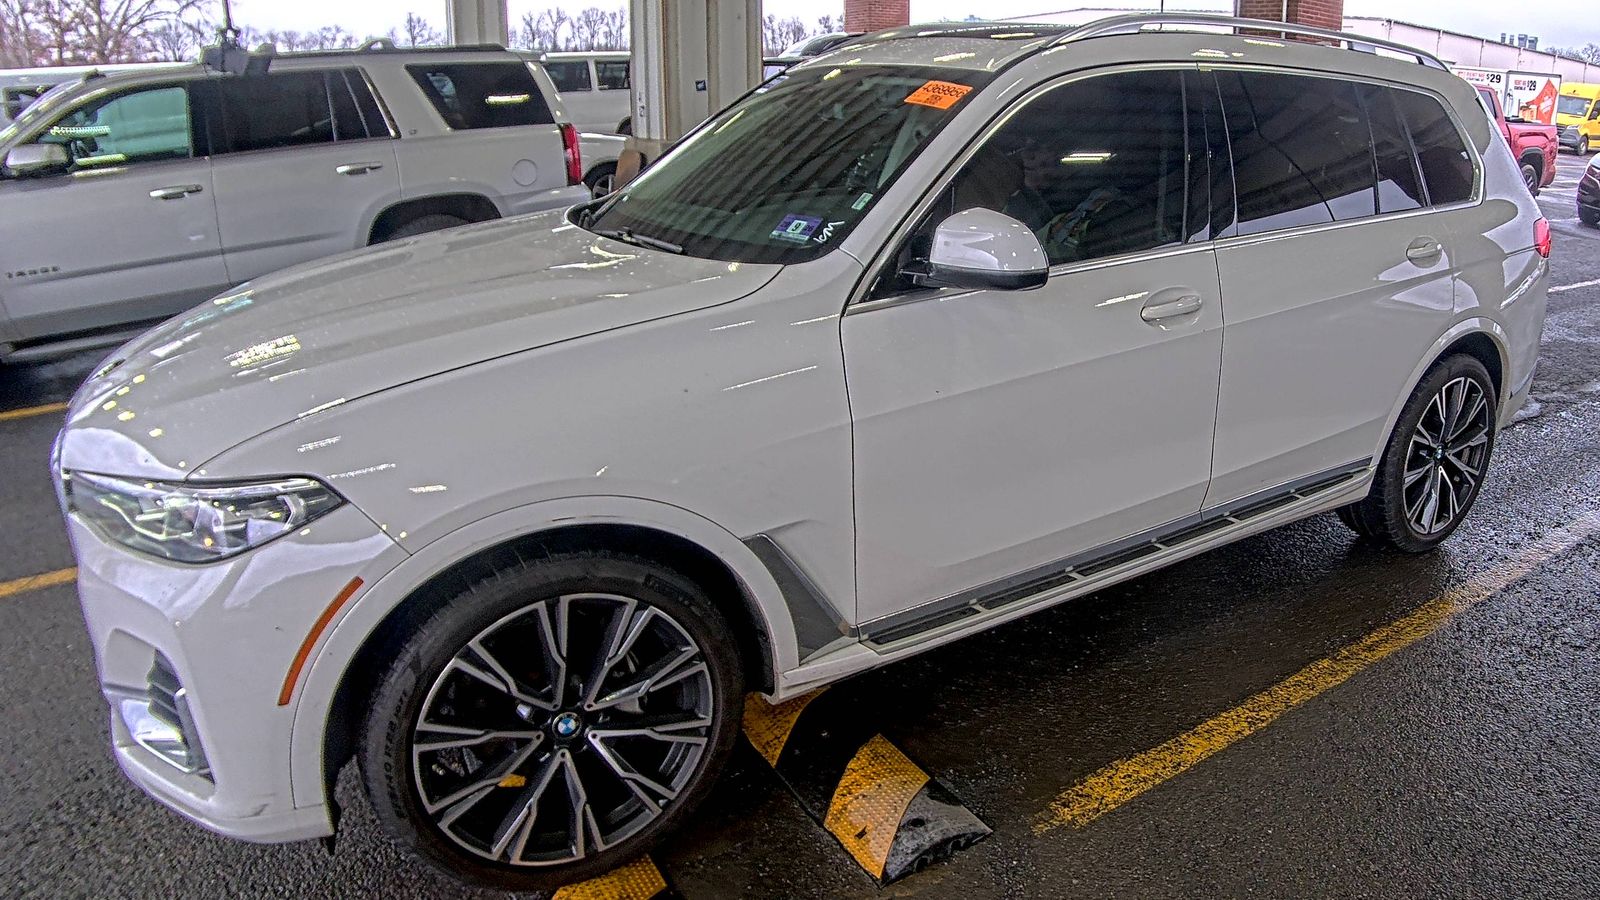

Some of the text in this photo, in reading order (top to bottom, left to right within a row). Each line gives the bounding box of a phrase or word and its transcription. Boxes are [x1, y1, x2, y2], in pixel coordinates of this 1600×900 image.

[1486, 73, 1501, 84] $29
[1527, 80, 1536, 91] $29
[791, 222, 801, 232] 9
